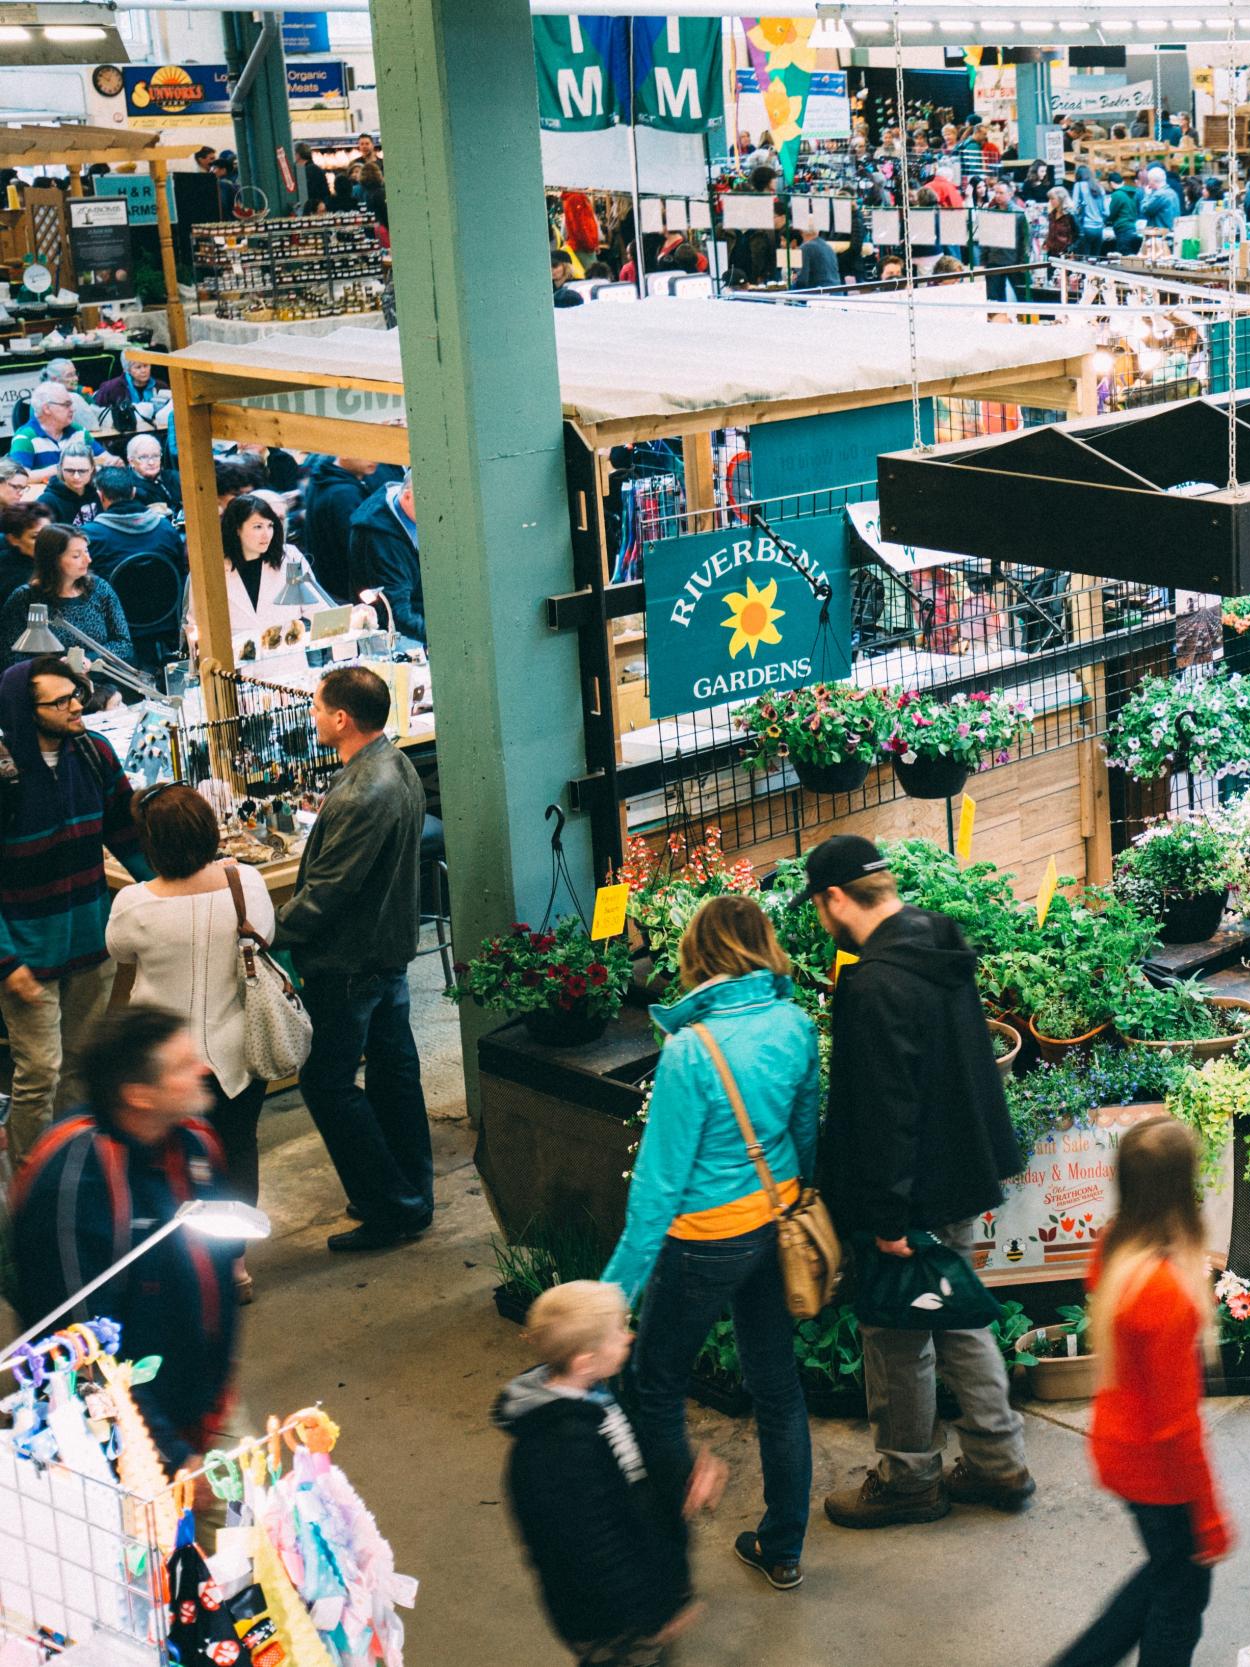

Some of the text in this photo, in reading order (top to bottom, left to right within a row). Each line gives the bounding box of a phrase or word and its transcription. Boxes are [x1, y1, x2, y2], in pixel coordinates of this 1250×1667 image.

[288, 70, 328, 81] Organic
[287, 84, 320, 93] Meats
[143, 186, 151, 197] R
[127, 204, 158, 216] ARMS
[692, 657, 813, 699] GARDENS
[1062, 1134, 1090, 1153] Sale
[1051, 1164, 1062, 1181] &
[1068, 1160, 1119, 1183] Monday
[1043, 1184, 1099, 1205] STRATHCONA
